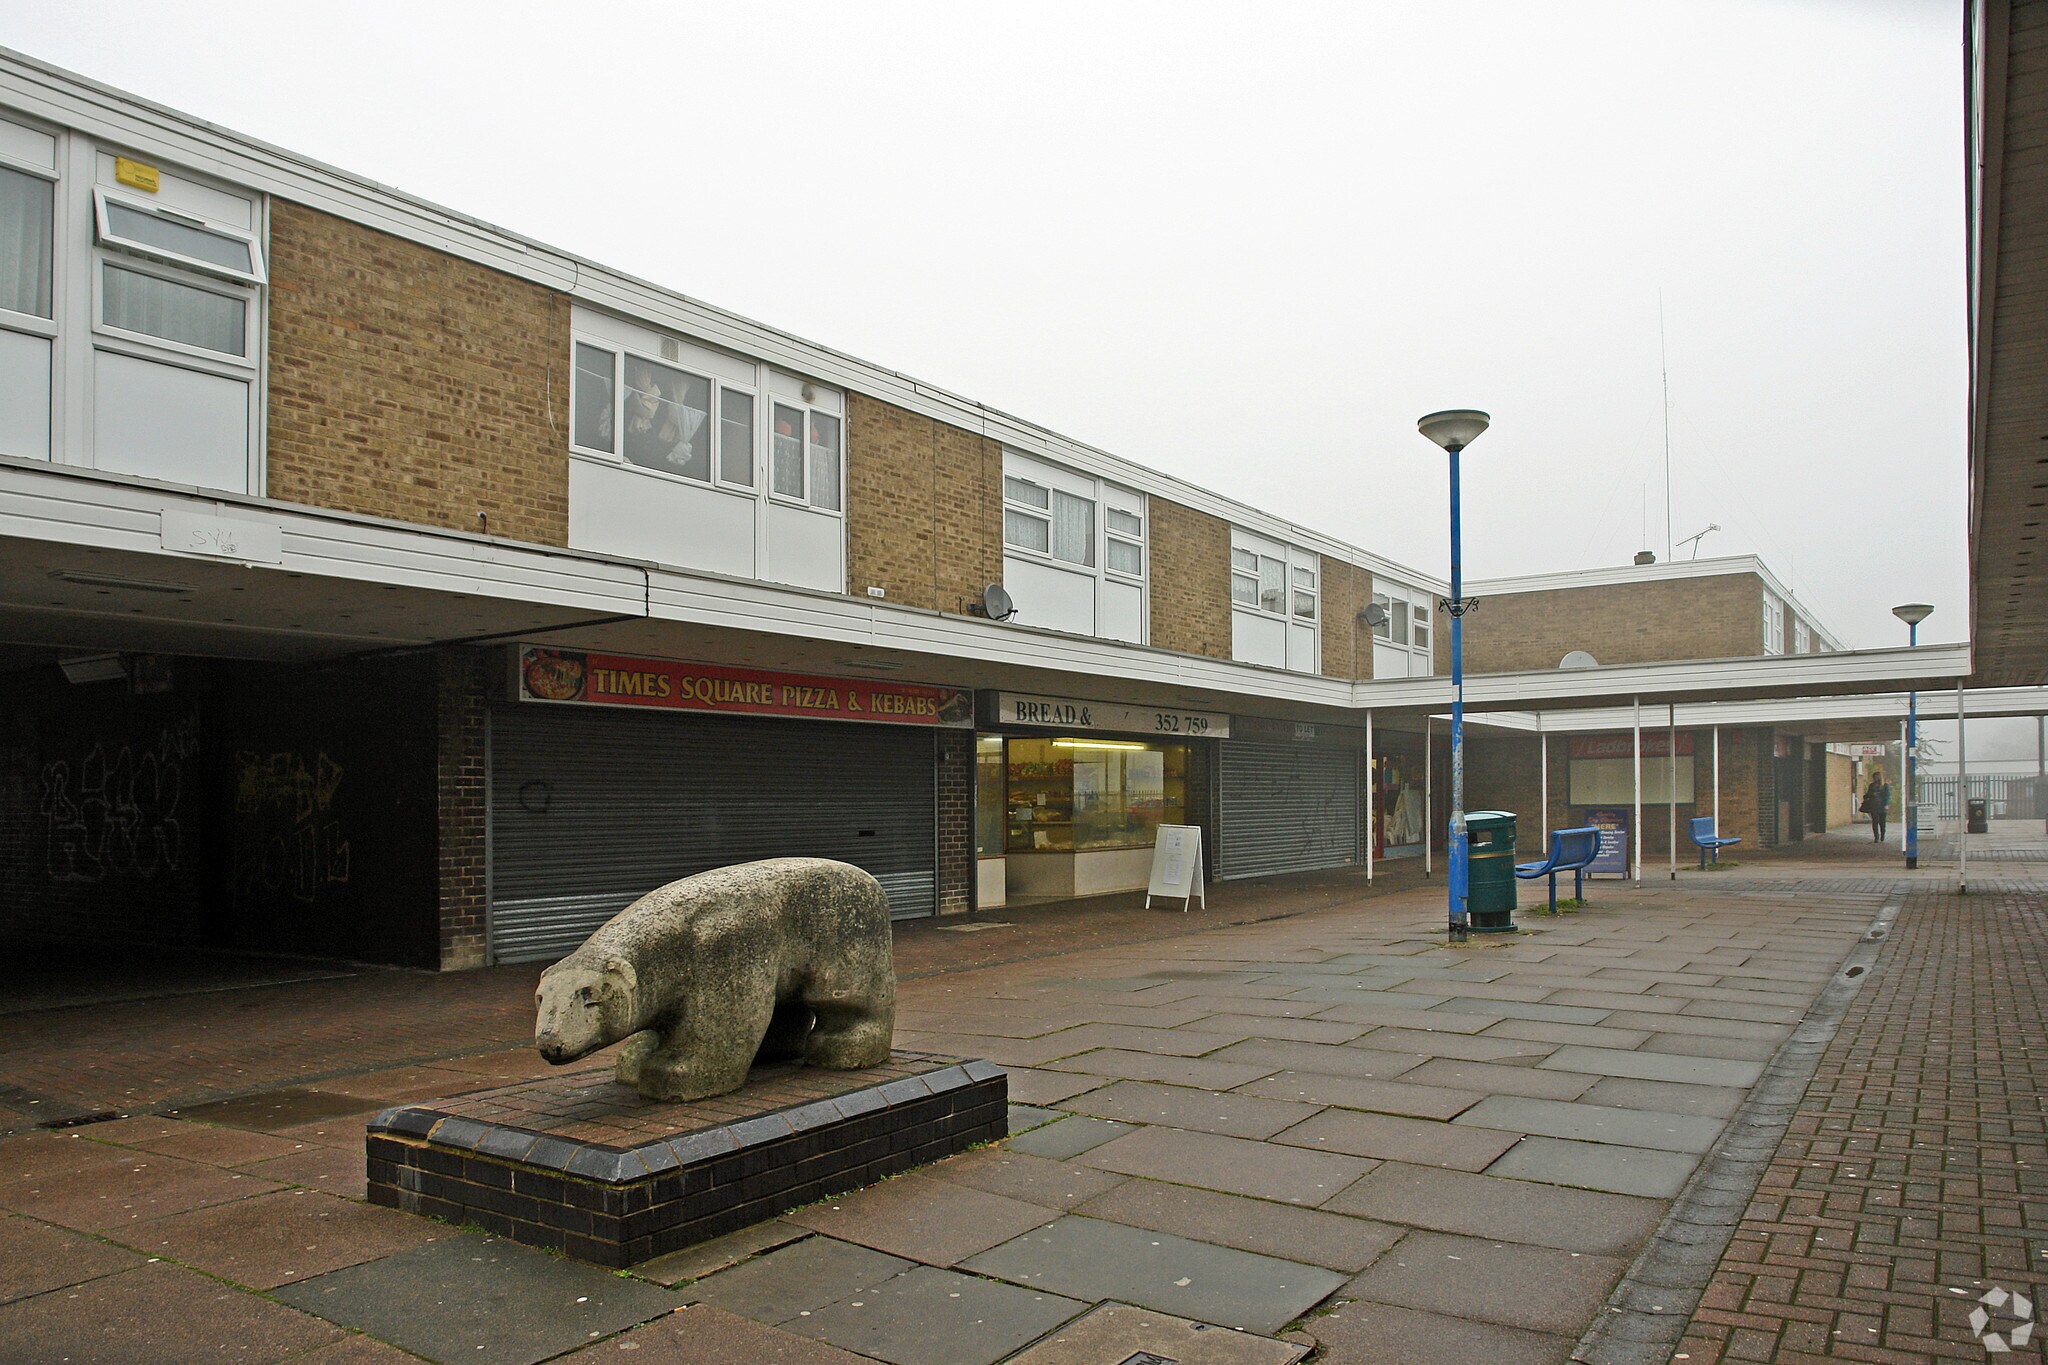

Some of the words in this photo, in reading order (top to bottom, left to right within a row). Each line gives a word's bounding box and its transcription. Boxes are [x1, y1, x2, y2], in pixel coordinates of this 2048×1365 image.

[592, 667, 672, 698] TIMES
[681, 675, 774, 707] SQUARE
[781, 684, 841, 711] PIZZA
[847, 690, 864, 712] &
[871, 692, 937, 717] KEBABS
[1015, 700, 1076, 725] BREAD
[1080, 705, 1092, 726] &
[1155, 712, 1179, 733] 352
[1184, 715, 1209, 735] 759
